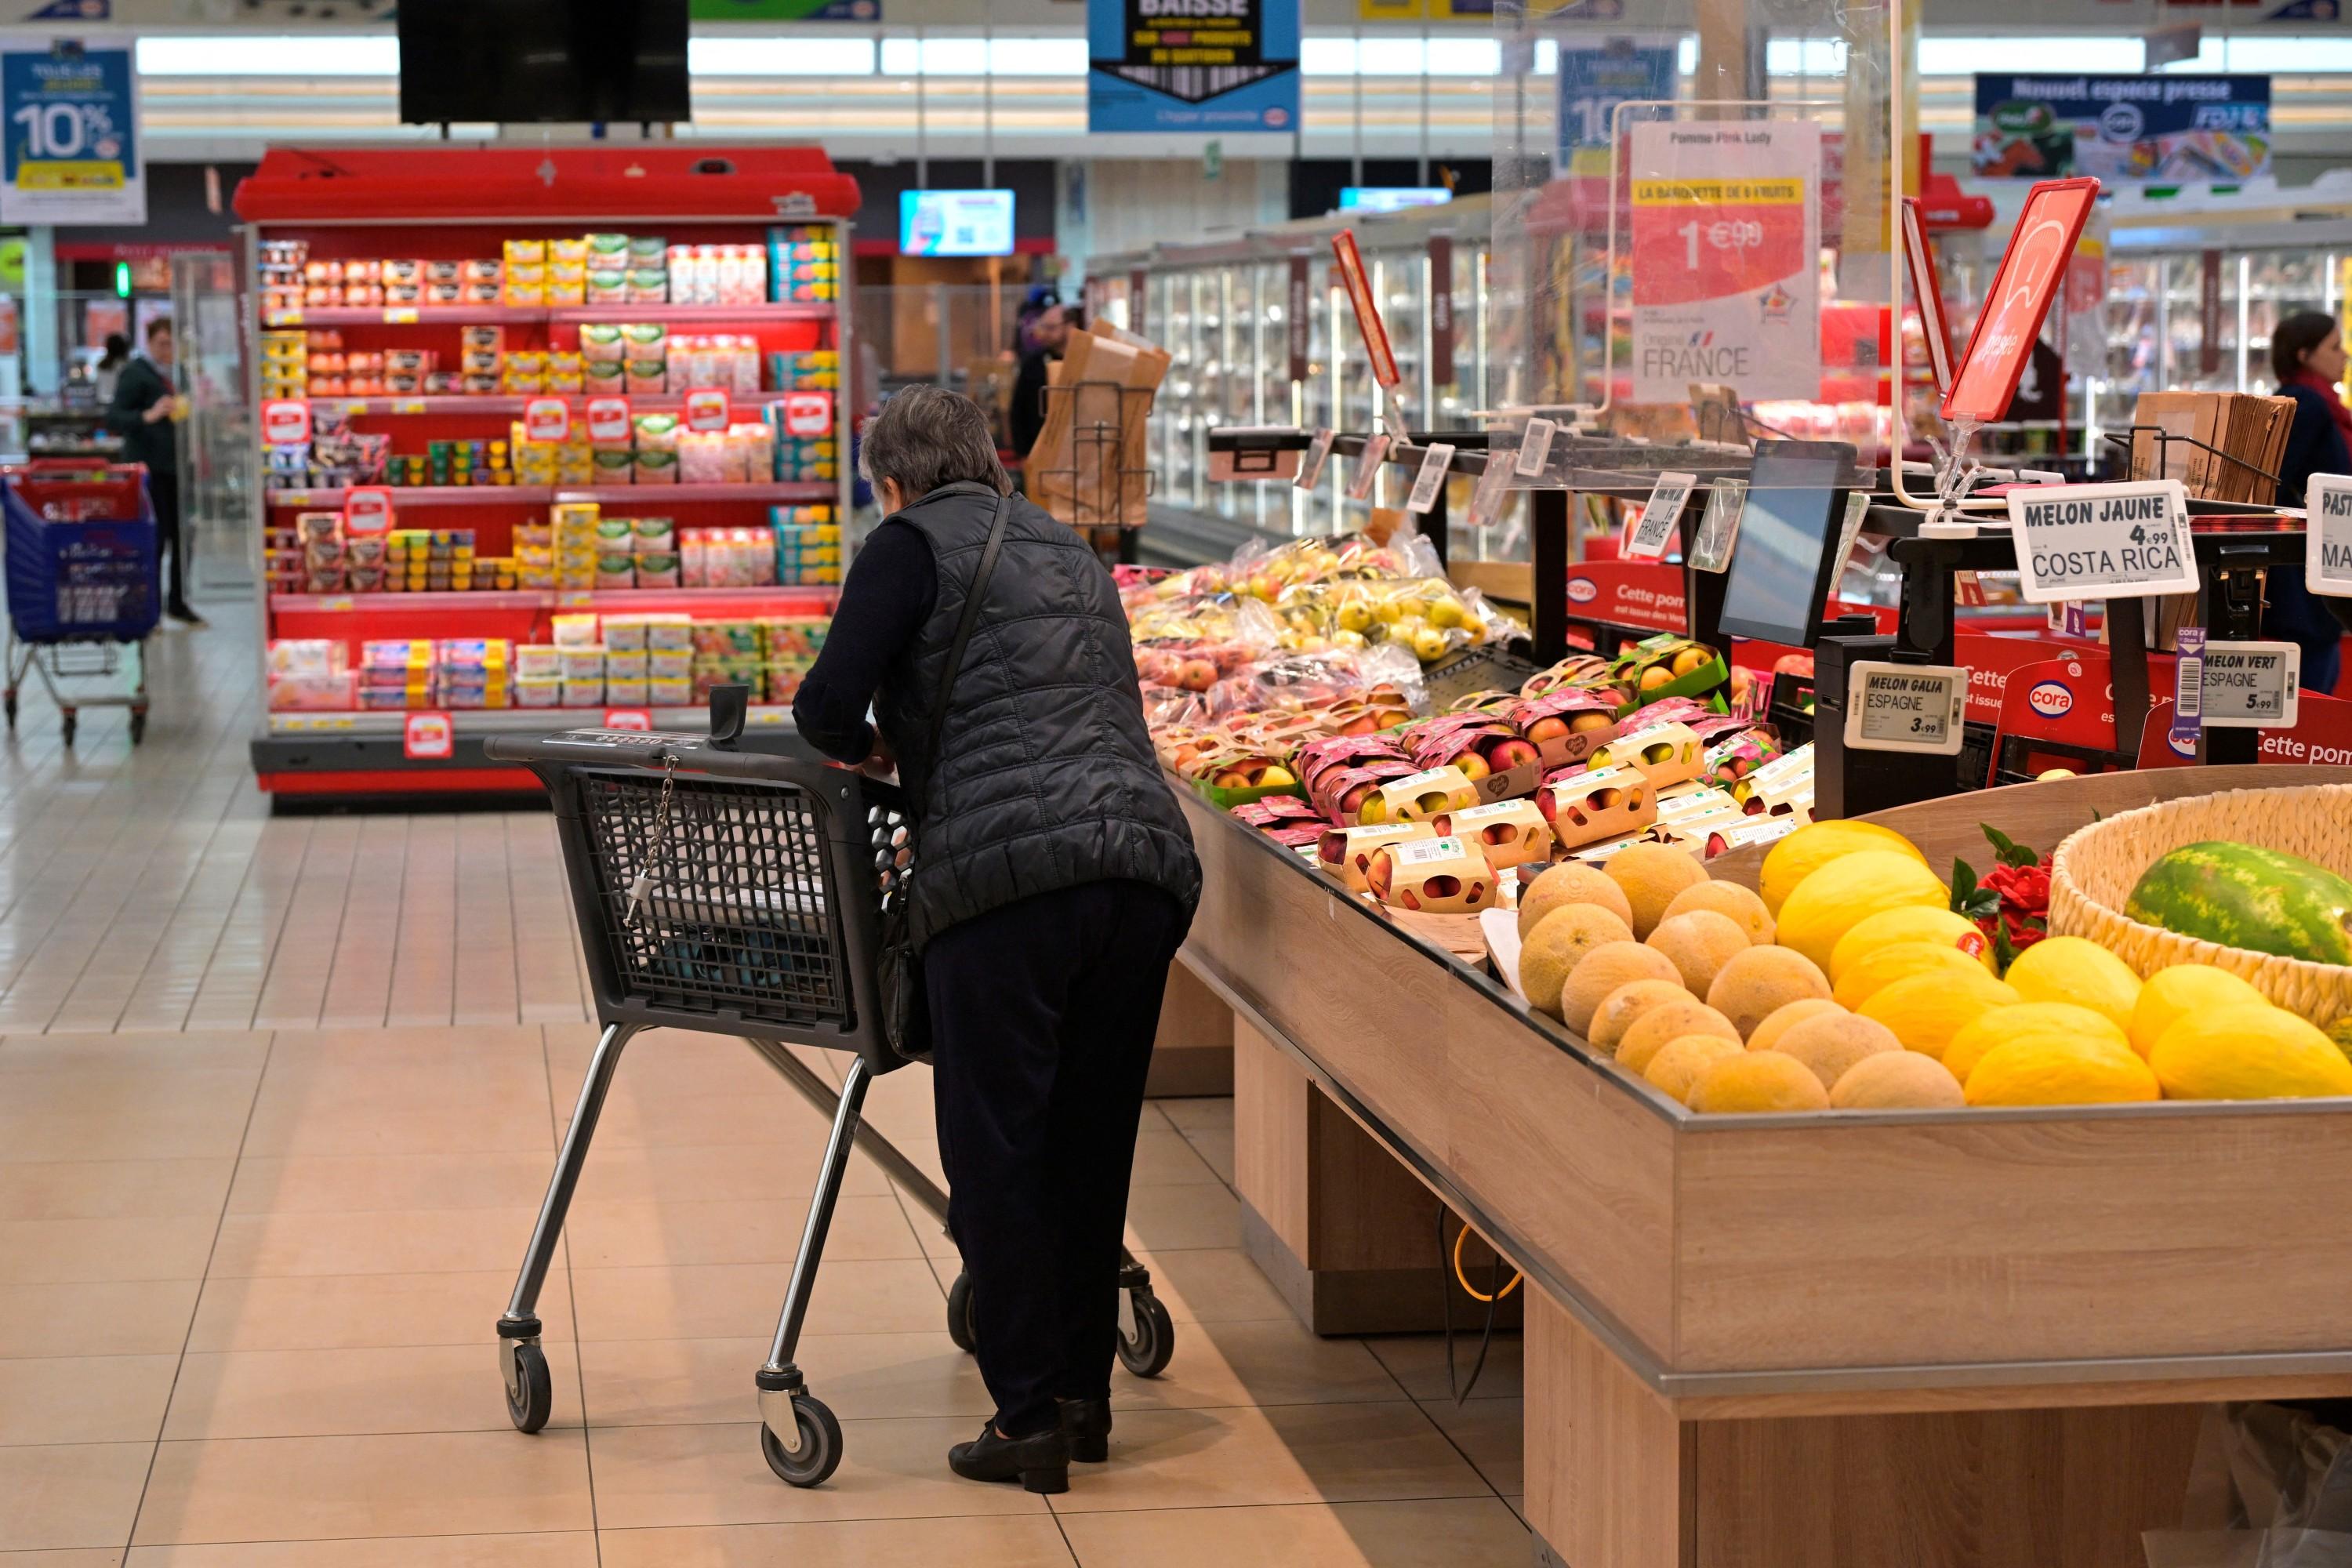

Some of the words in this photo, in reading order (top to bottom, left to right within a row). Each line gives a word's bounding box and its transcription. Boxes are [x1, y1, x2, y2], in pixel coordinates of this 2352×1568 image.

[2012, 80, 2088, 100] Nouvel
[2091, 82, 2160, 103] espace
[2163, 82, 2231, 103] presse
[1670, 132, 1712, 144] Pomme
[1715, 132, 1741, 143] Pink
[1744, 132, 1772, 145] Lady
[1639, 187, 1653, 200] LA
[1657, 186, 1721, 198] BARQUETTE
[1726, 186, 1740, 198] DE
[1643, 347, 1751, 378] FRANCE
[2025, 502, 2092, 528] MELON
[2100, 497, 2164, 523] JAUNE
[1640, 519, 1670, 539] FRANCE
[2032, 550, 2115, 578] COSTA
[2122, 546, 2180, 571] RICA
[1617, 584, 1654, 603] Cette
[2204, 655, 2244, 669] MELON
[2247, 656, 2277, 670] VERT
[1869, 677, 1908, 691] MELON
[1911, 680, 1943, 694] GALIA
[2202, 673, 2257, 688] ESPAGNE
[1867, 693, 1924, 712] ESPAGNE
[2031, 691, 2070, 709] cora
